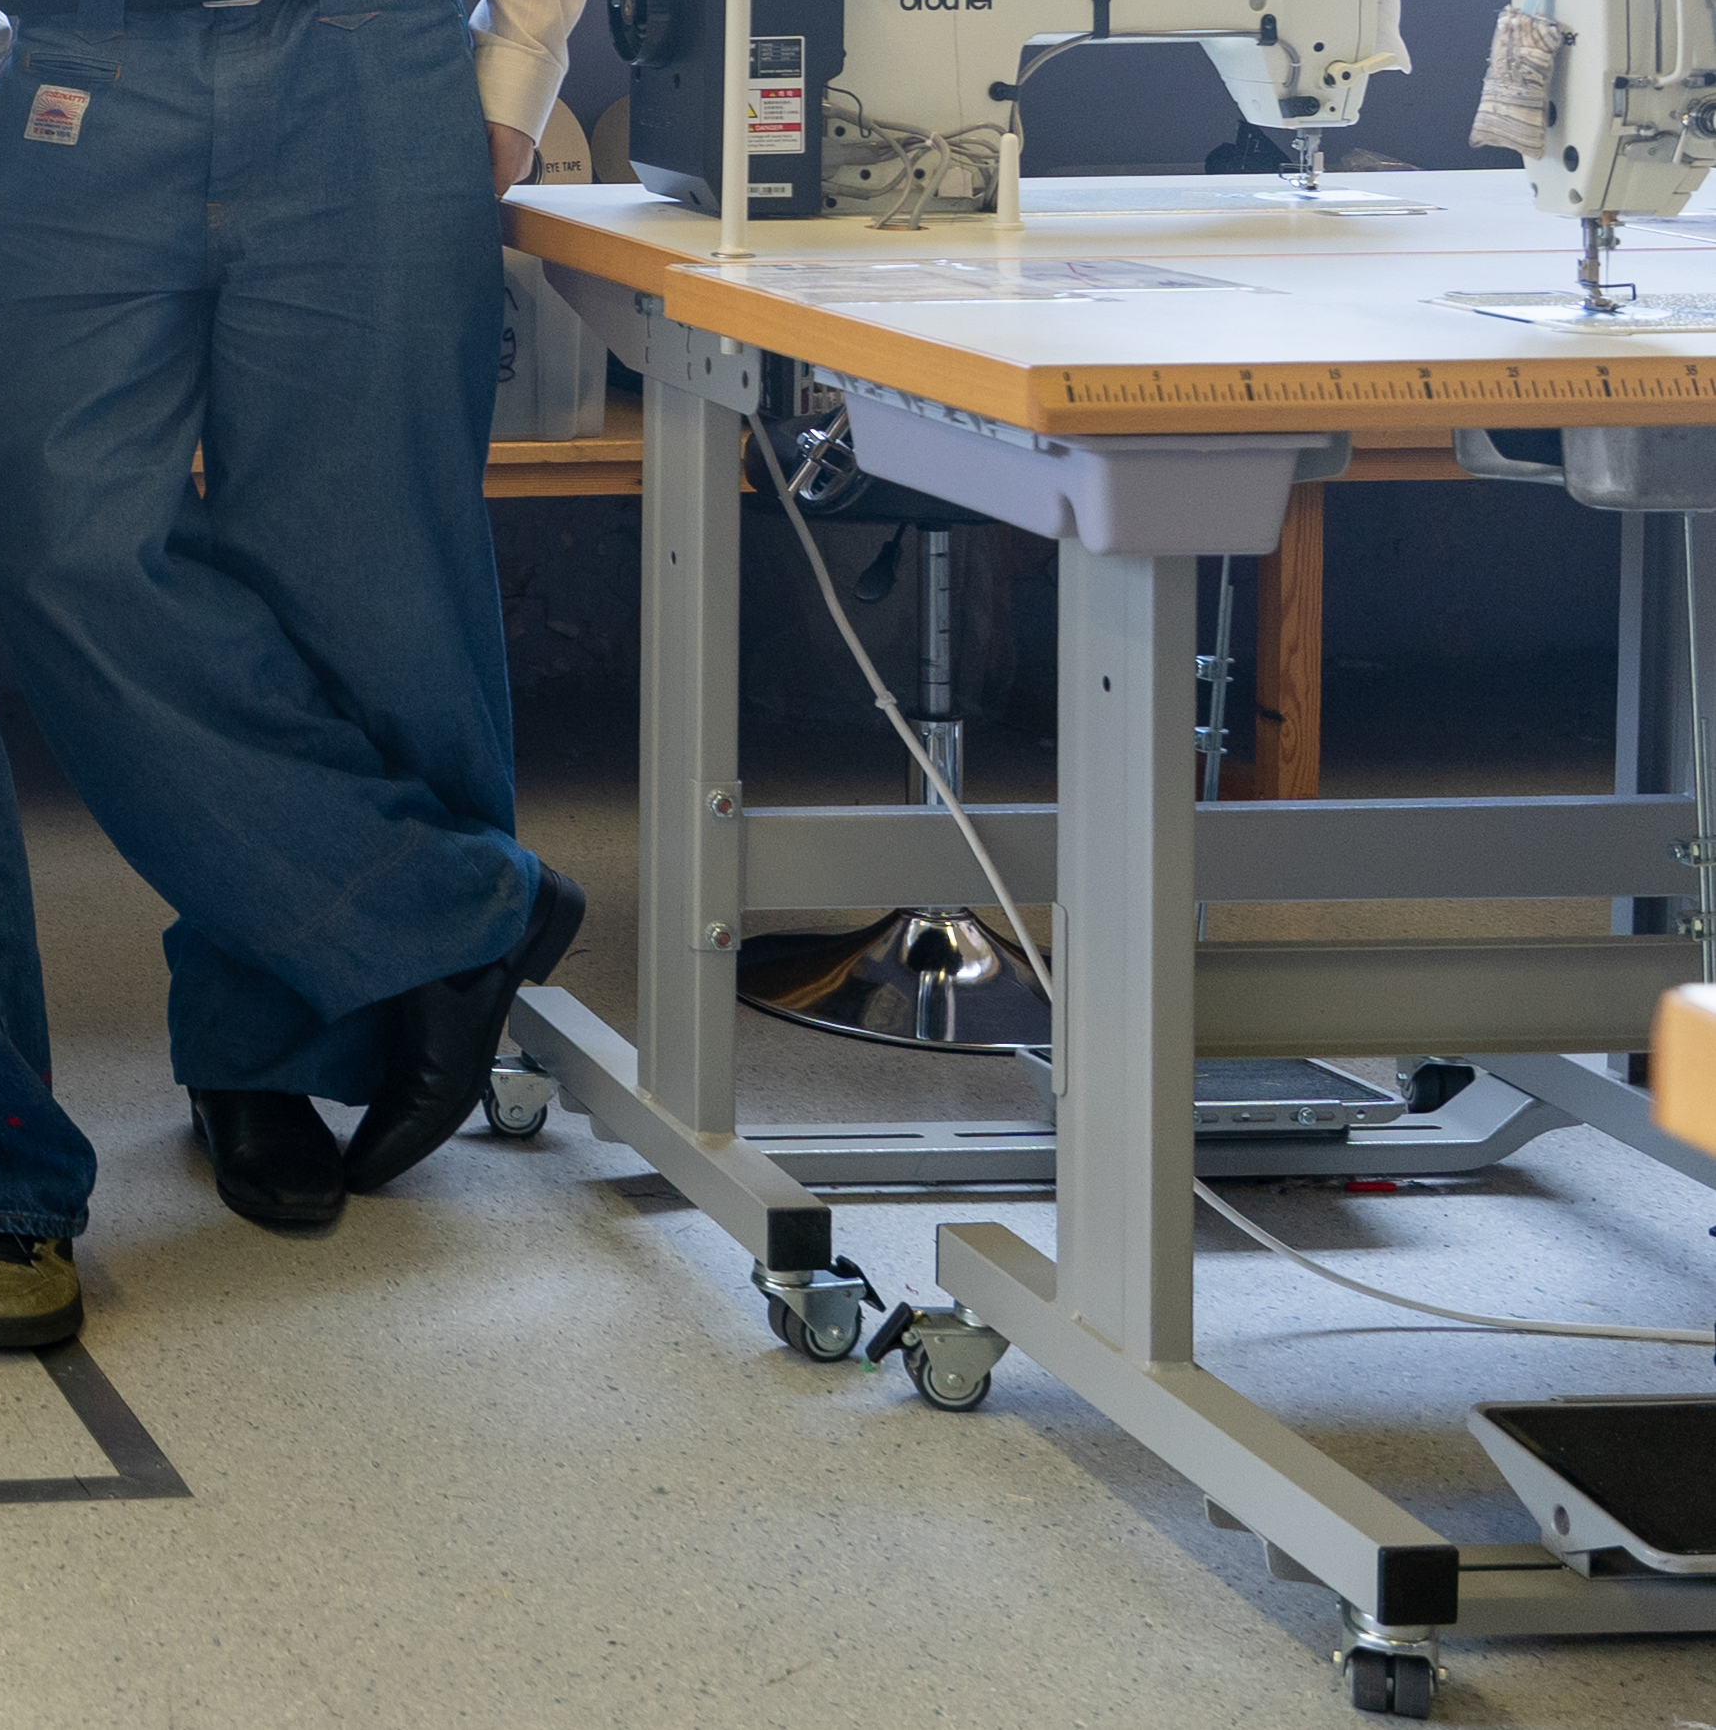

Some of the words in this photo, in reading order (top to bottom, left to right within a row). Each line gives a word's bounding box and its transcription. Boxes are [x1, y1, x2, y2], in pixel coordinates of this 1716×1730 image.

[545, 162, 560, 174] EYE
[562, 160, 582, 172] TAPE
[1152, 370, 1161, 381] 5
[1239, 370, 1252, 381] 10
[1328, 369, 1341, 380] 15
[1418, 367, 1431, 379] 20
[1506, 366, 1519, 378] 25
[1596, 366, 1610, 377] 30
[1685, 364, 1698, 376] 35
